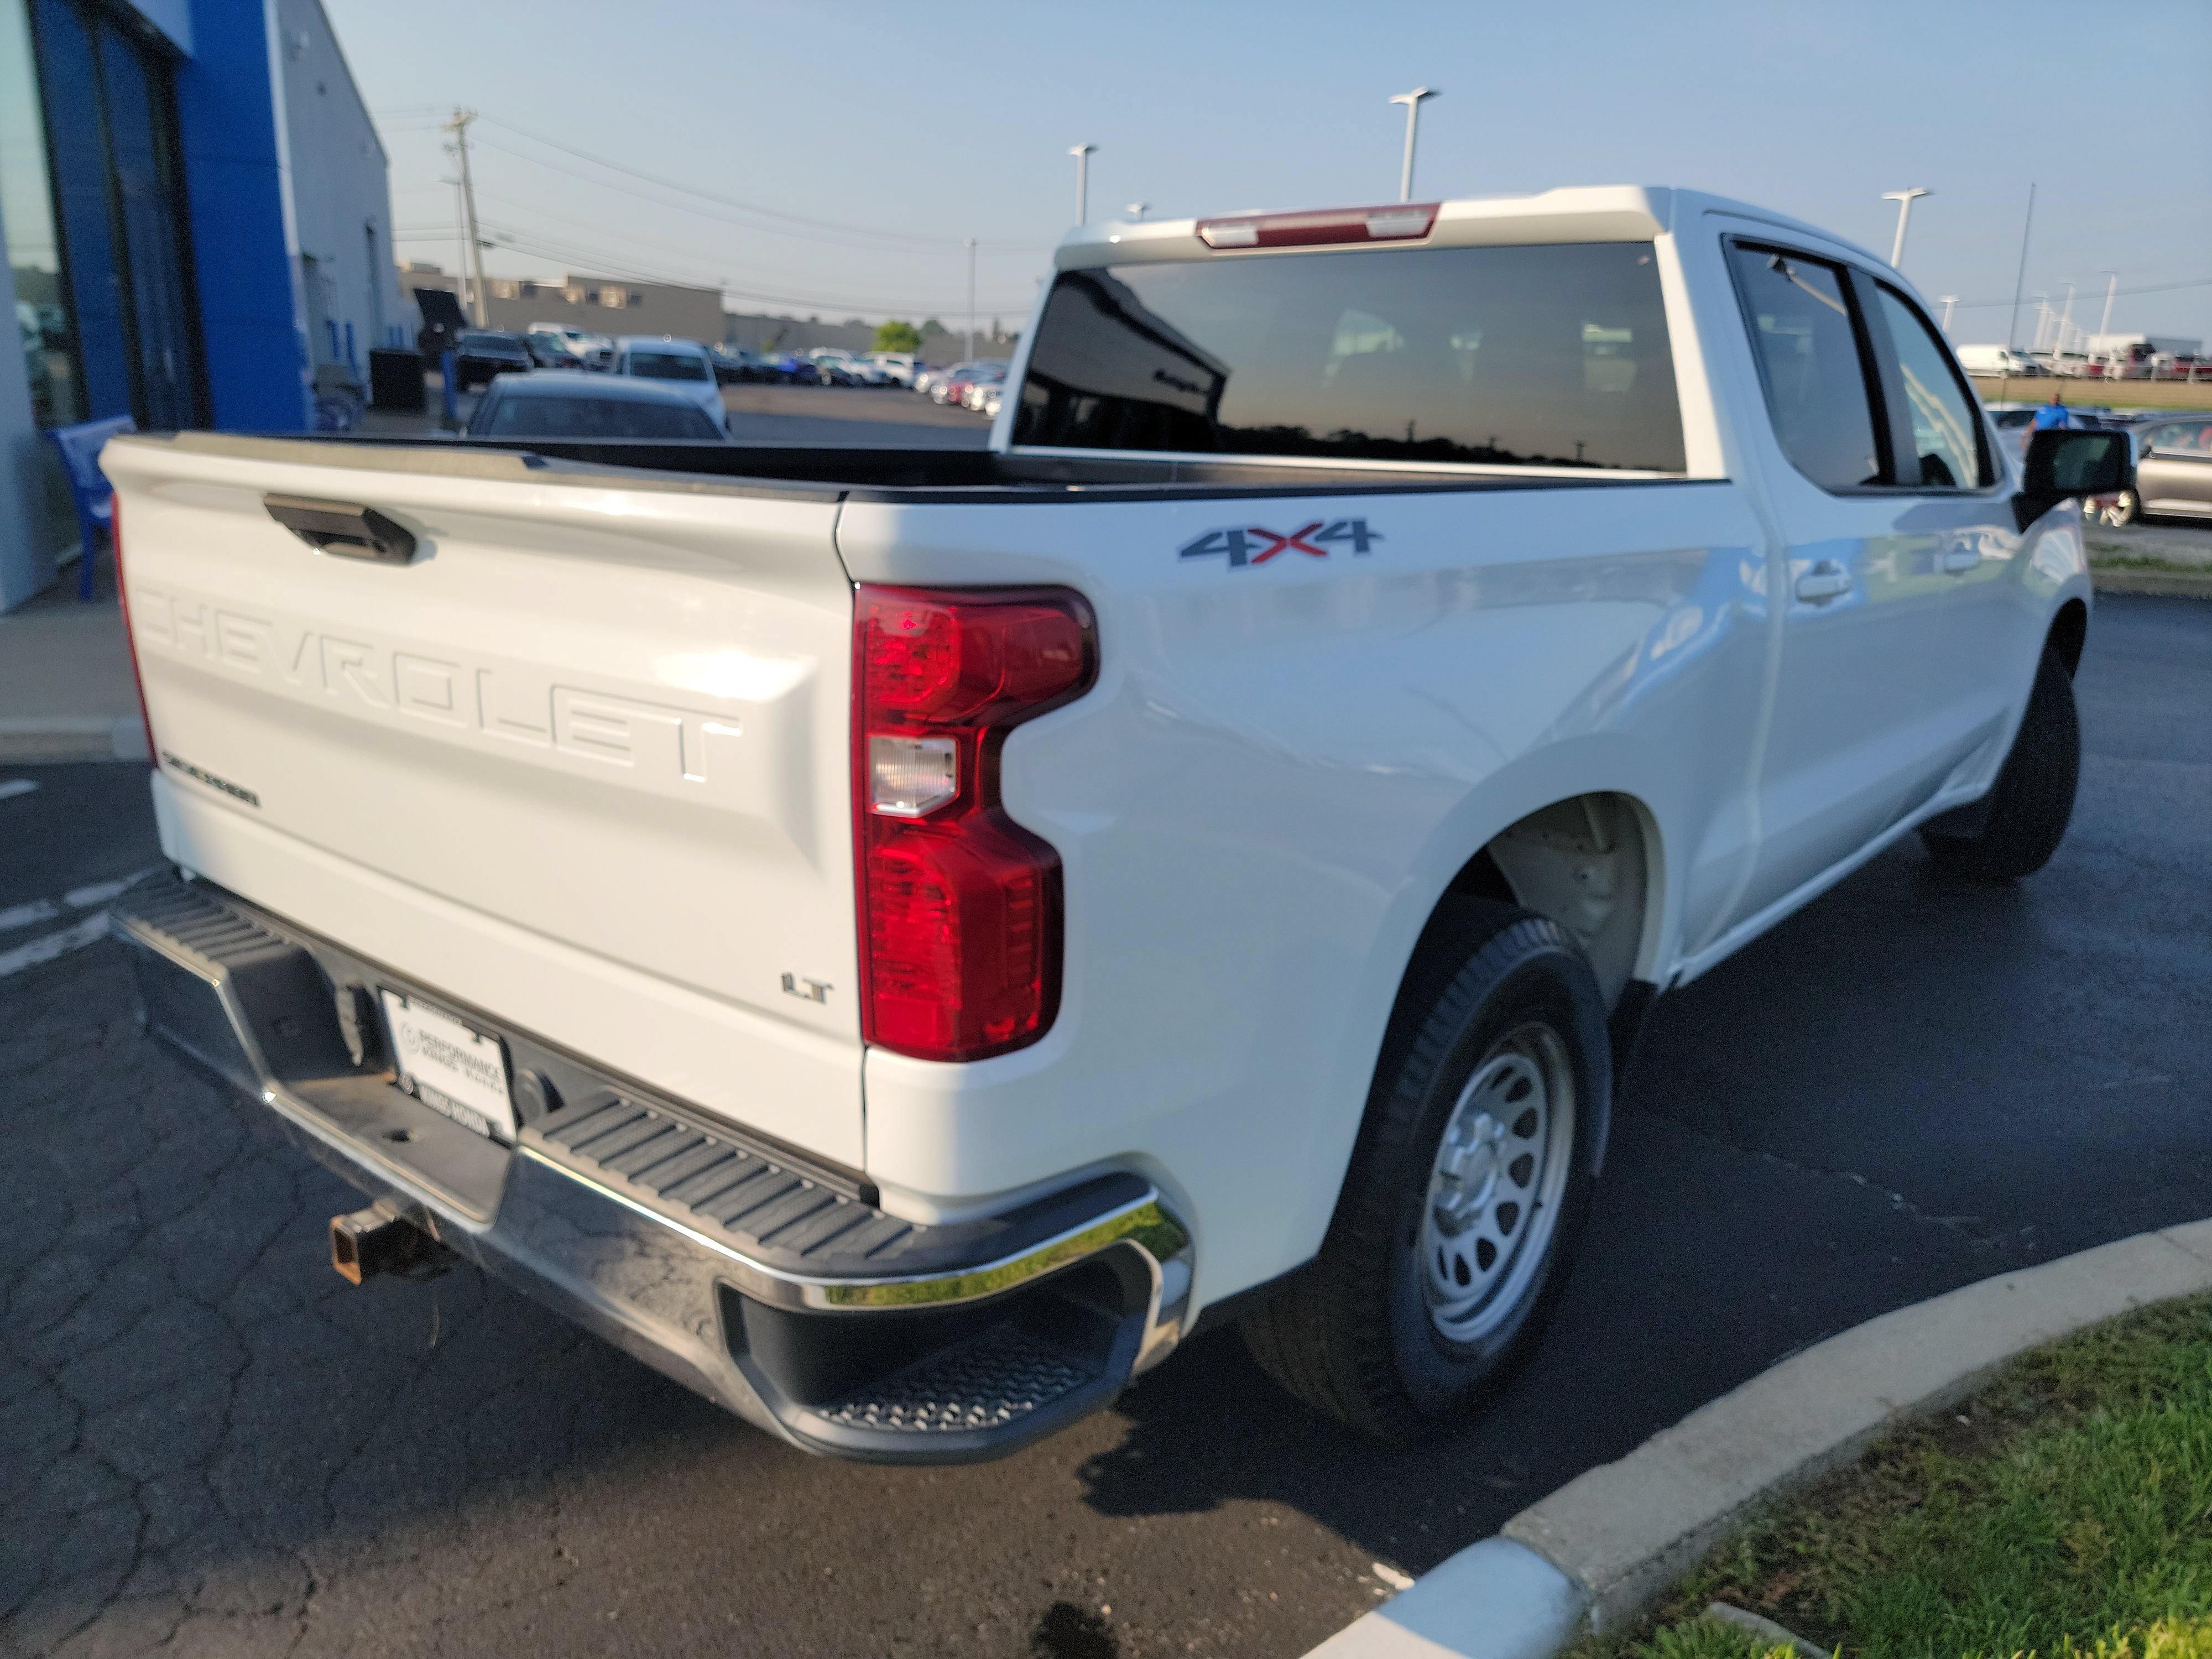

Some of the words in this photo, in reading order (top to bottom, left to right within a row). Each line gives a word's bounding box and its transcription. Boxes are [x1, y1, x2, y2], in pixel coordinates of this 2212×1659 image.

[135, 586, 741, 783] CHEVROLET
[781, 972, 834, 1005] LT
[419, 1029, 502, 1080] PERFORMANCE
[451, 1100, 490, 1138] HONDA
